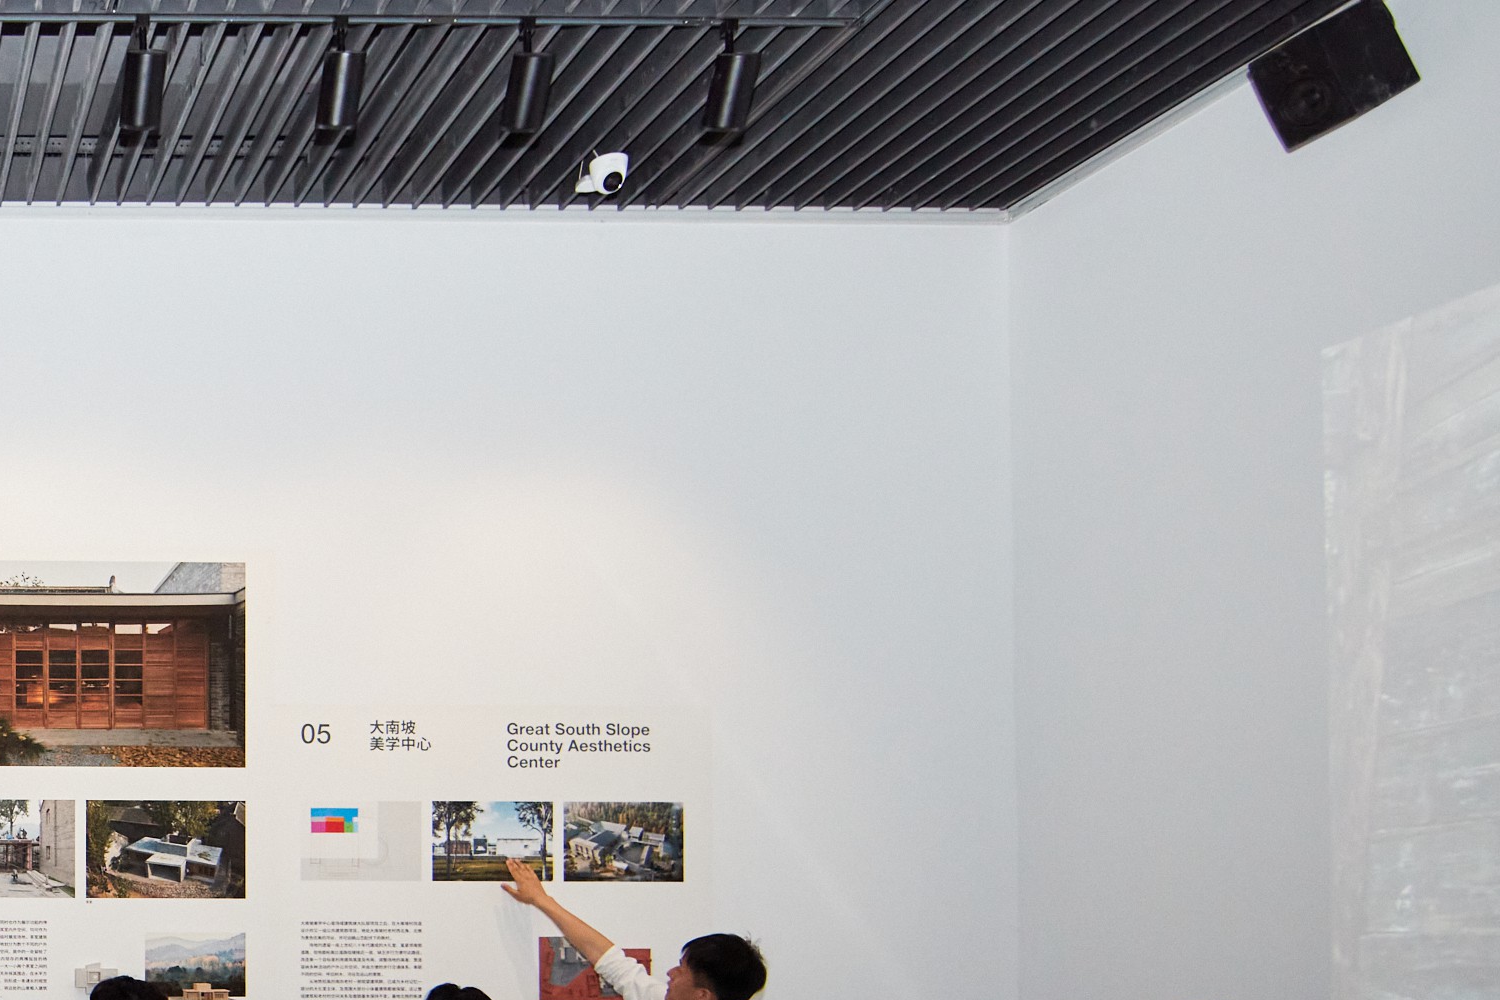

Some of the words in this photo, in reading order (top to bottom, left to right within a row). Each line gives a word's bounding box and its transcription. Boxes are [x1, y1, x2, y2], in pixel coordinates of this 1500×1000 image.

[302, 724, 330, 744] 05
[370, 720, 415, 734] 大南坡
[507, 723, 549, 735] Great
[556, 723, 600, 735] South
[606, 723, 649, 738] Slope
[370, 737, 431, 751] 美学中心
[507, 739, 563, 754] County
[568, 740, 650, 752] Aesthetics
[508, 756, 560, 768] Center
